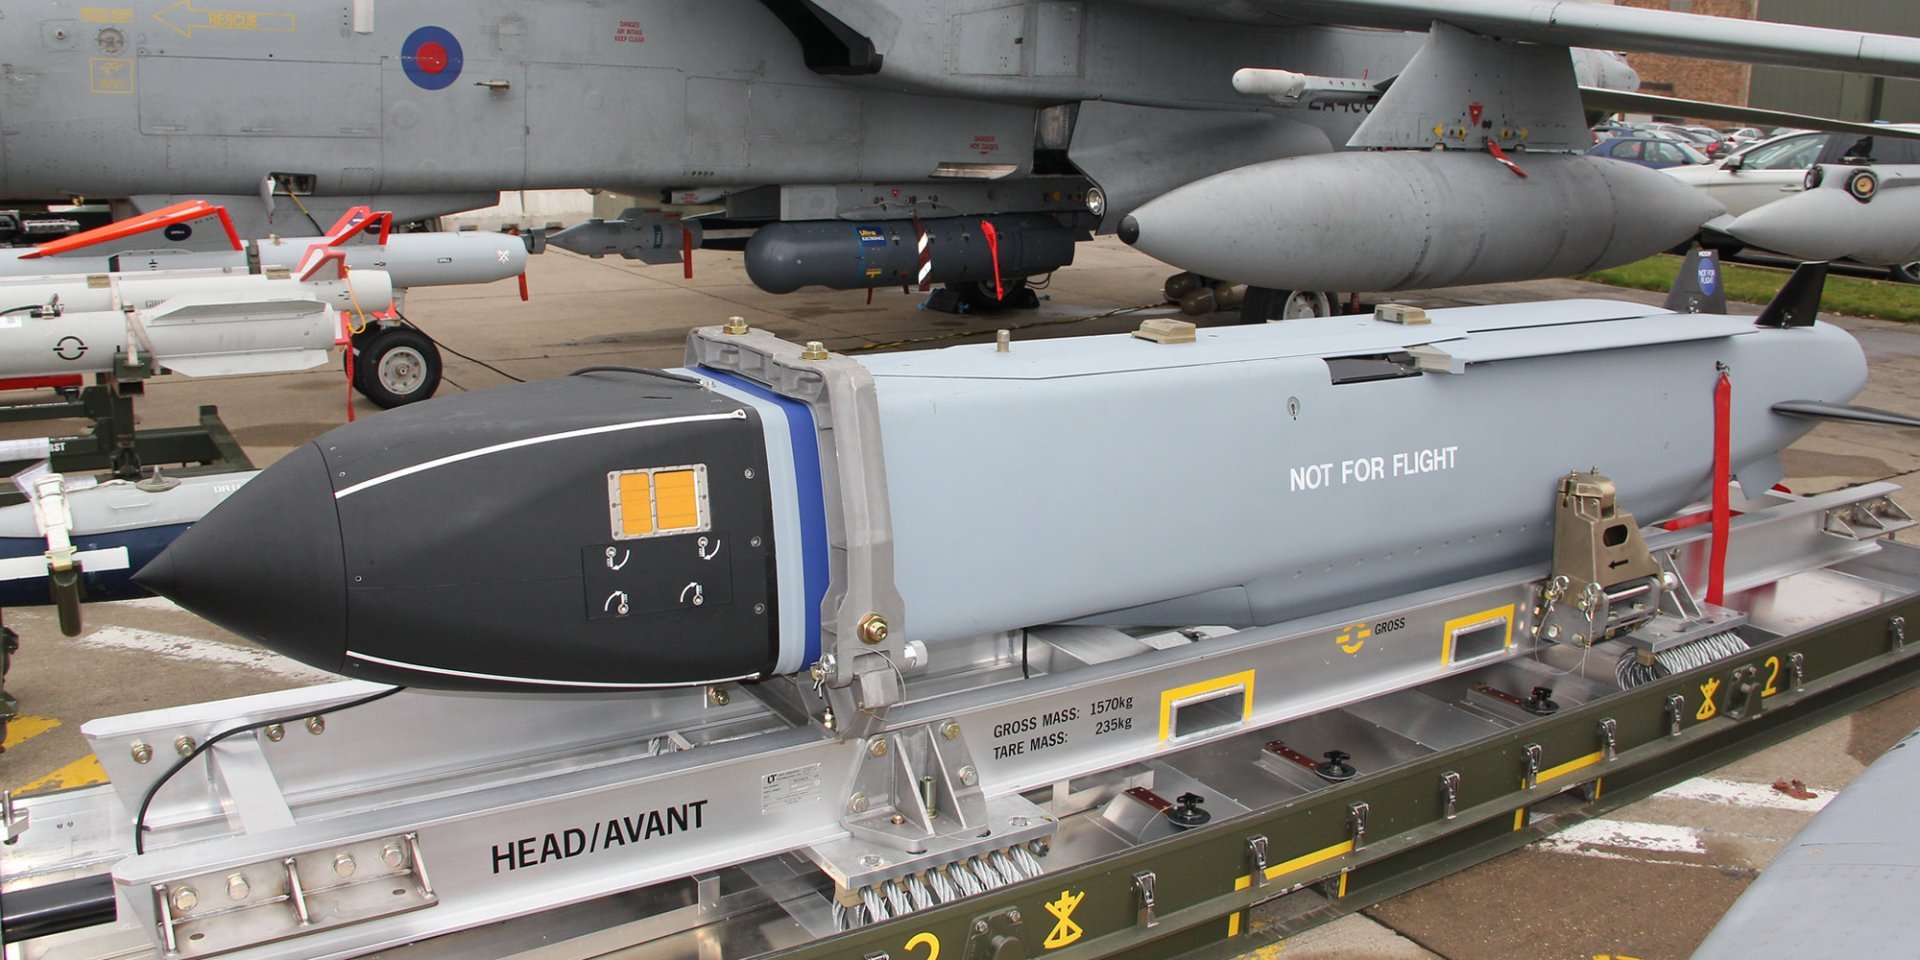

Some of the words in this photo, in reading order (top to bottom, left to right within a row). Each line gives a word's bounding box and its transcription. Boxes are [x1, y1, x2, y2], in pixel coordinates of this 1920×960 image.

[207, 12, 258, 29] RESCUE
[859, 229, 877, 237] Ultra
[1289, 463, 1333, 492] NOT
[1341, 456, 1385, 484] FOR
[1392, 446, 1458, 477] FLIGHT
[1374, 617, 1406, 635] GROSS
[1761, 656, 1780, 698] 2
[993, 716, 1037, 738] GROSS
[1042, 707, 1080, 727] MASS:
[1090, 696, 1134, 716] 1570kg
[993, 741, 1025, 760] TARE
[1030, 731, 1068, 752] MASS:
[1095, 717, 1132, 735] 235kg
[491, 799, 708, 874] HEAD/AVANT
[904, 932, 940, 960] 2
